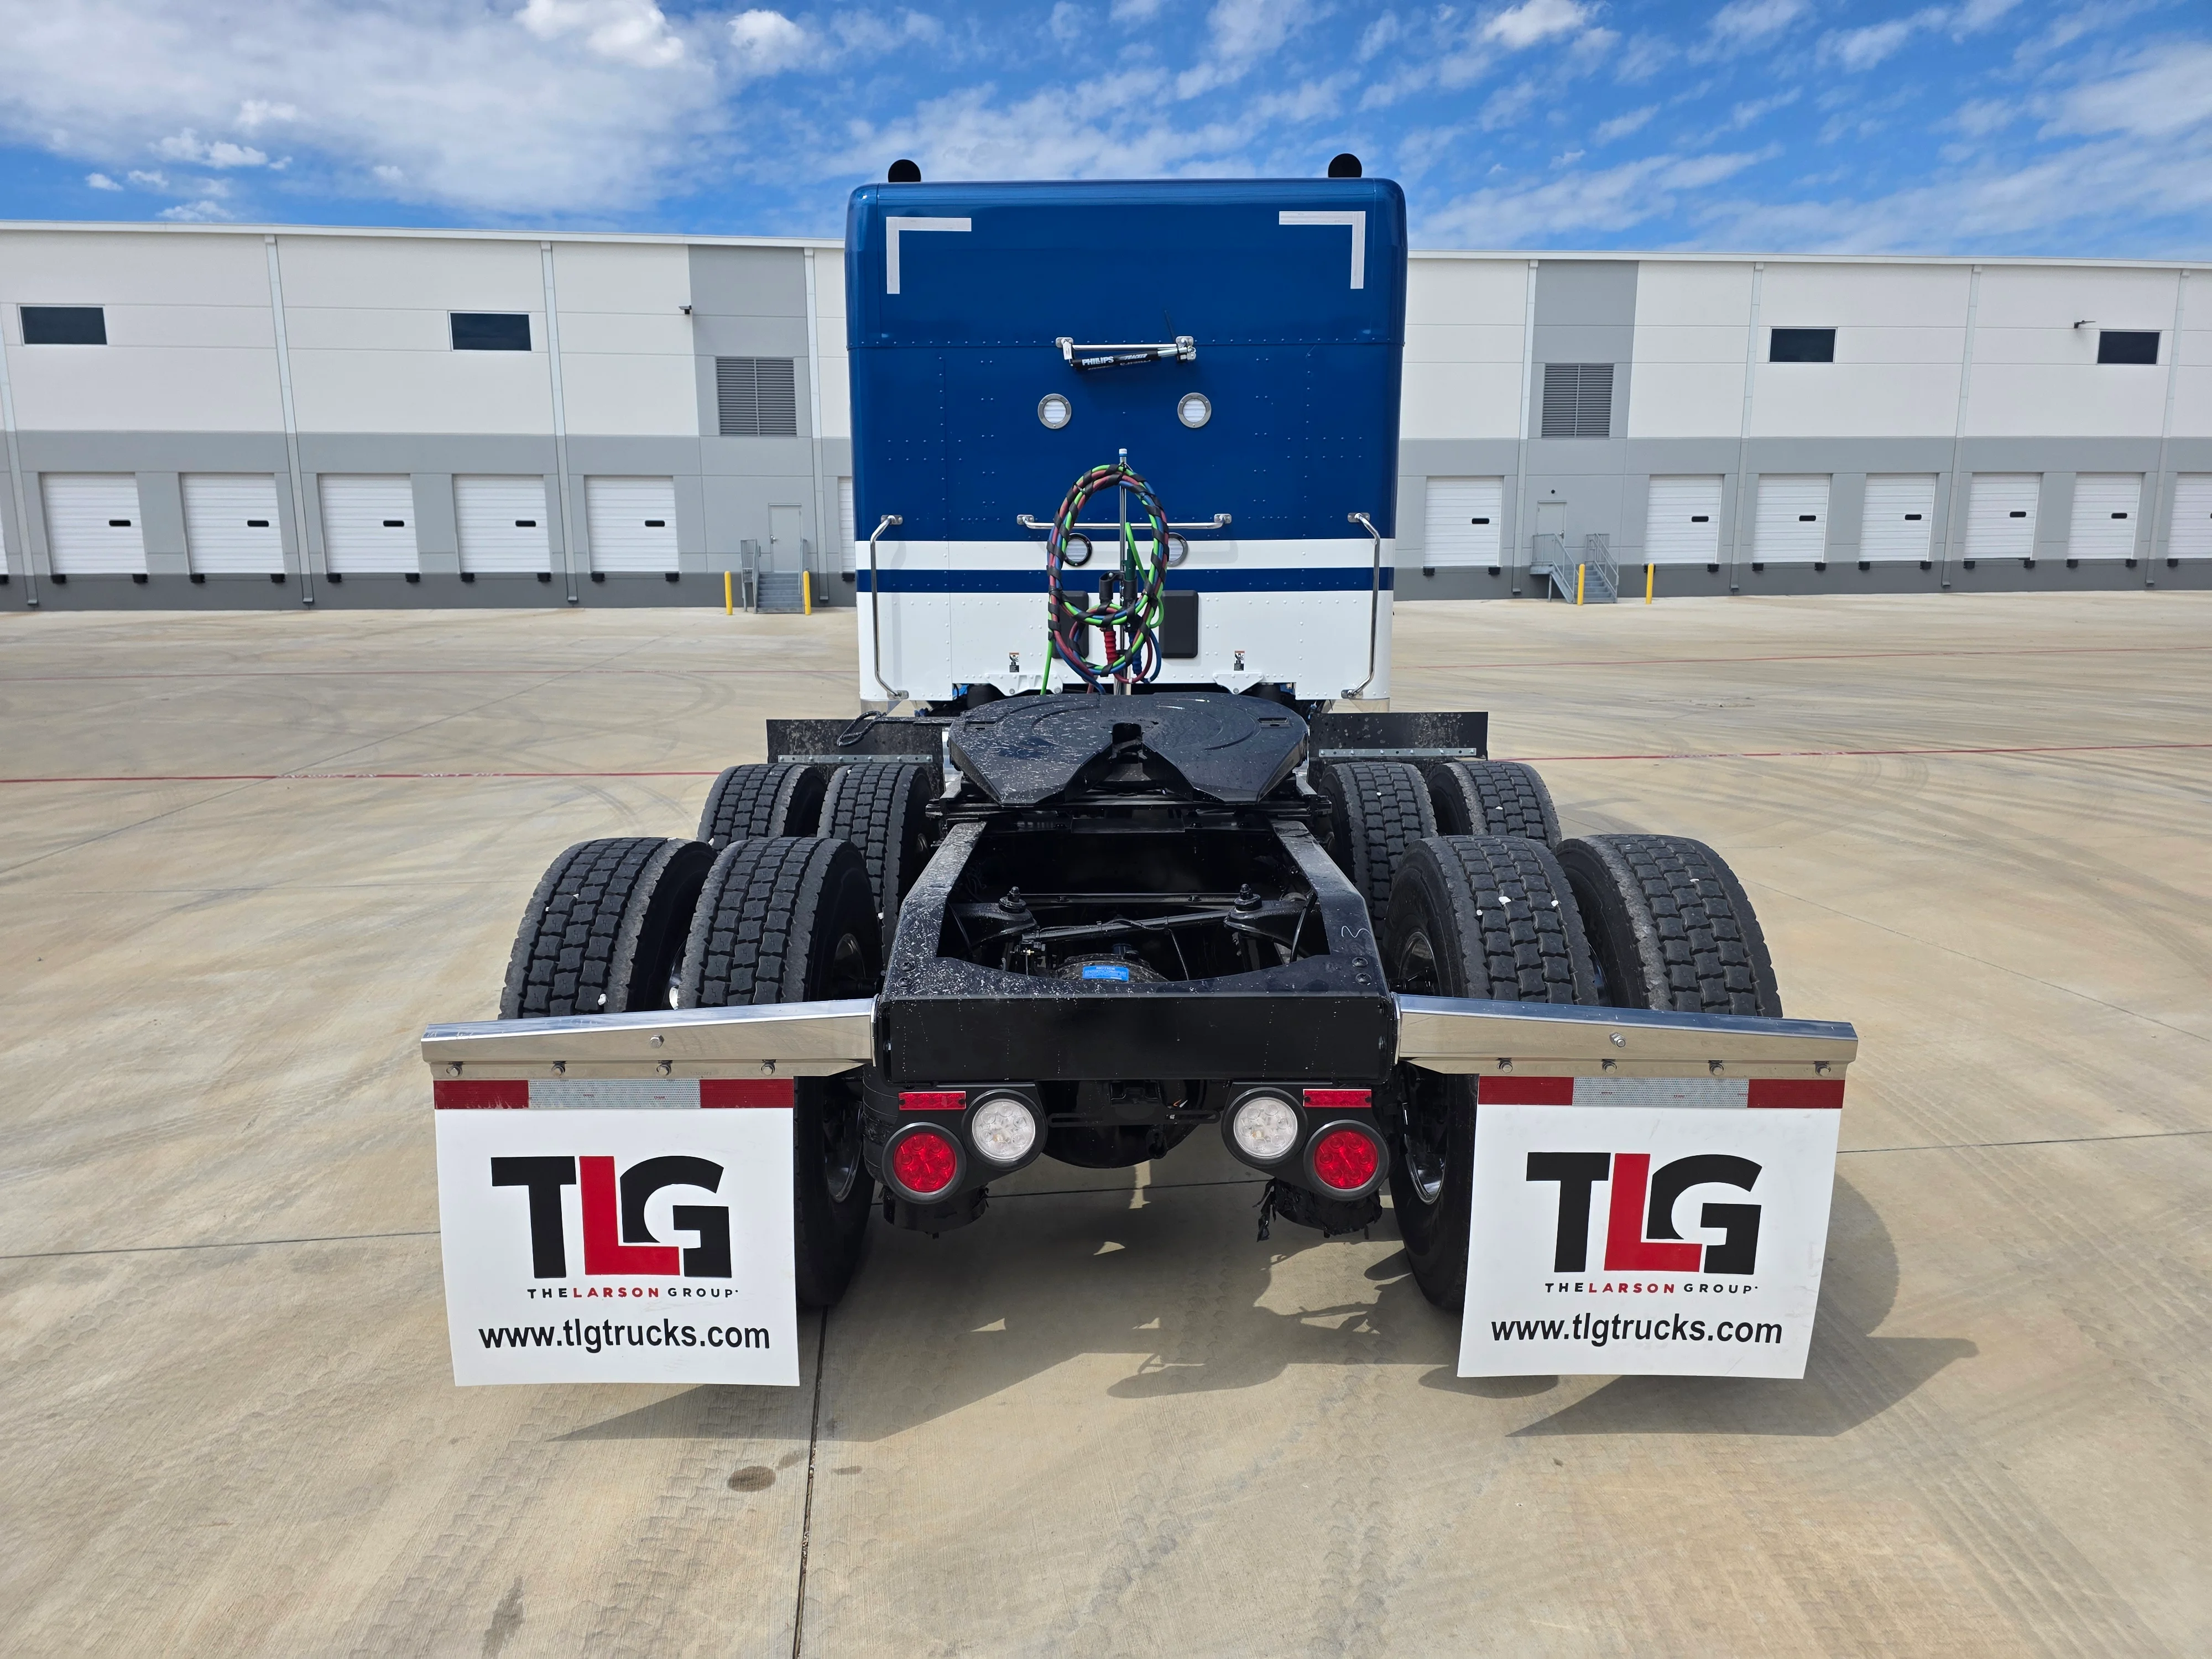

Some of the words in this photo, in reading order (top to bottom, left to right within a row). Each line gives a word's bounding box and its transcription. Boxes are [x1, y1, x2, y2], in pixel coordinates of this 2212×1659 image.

[1082, 356, 1114, 366] PHILLIPS
[491, 1155, 732, 1279] TLG
[1526, 1152, 1762, 1275] TLG
[667, 1287, 733, 1298] GROUP
[1683, 1283, 1752, 1294] GROUP
[478, 1318, 770, 1354] www.tlgtrucks.com
[1491, 1312, 1782, 1347] www.tlgtrucks.com
